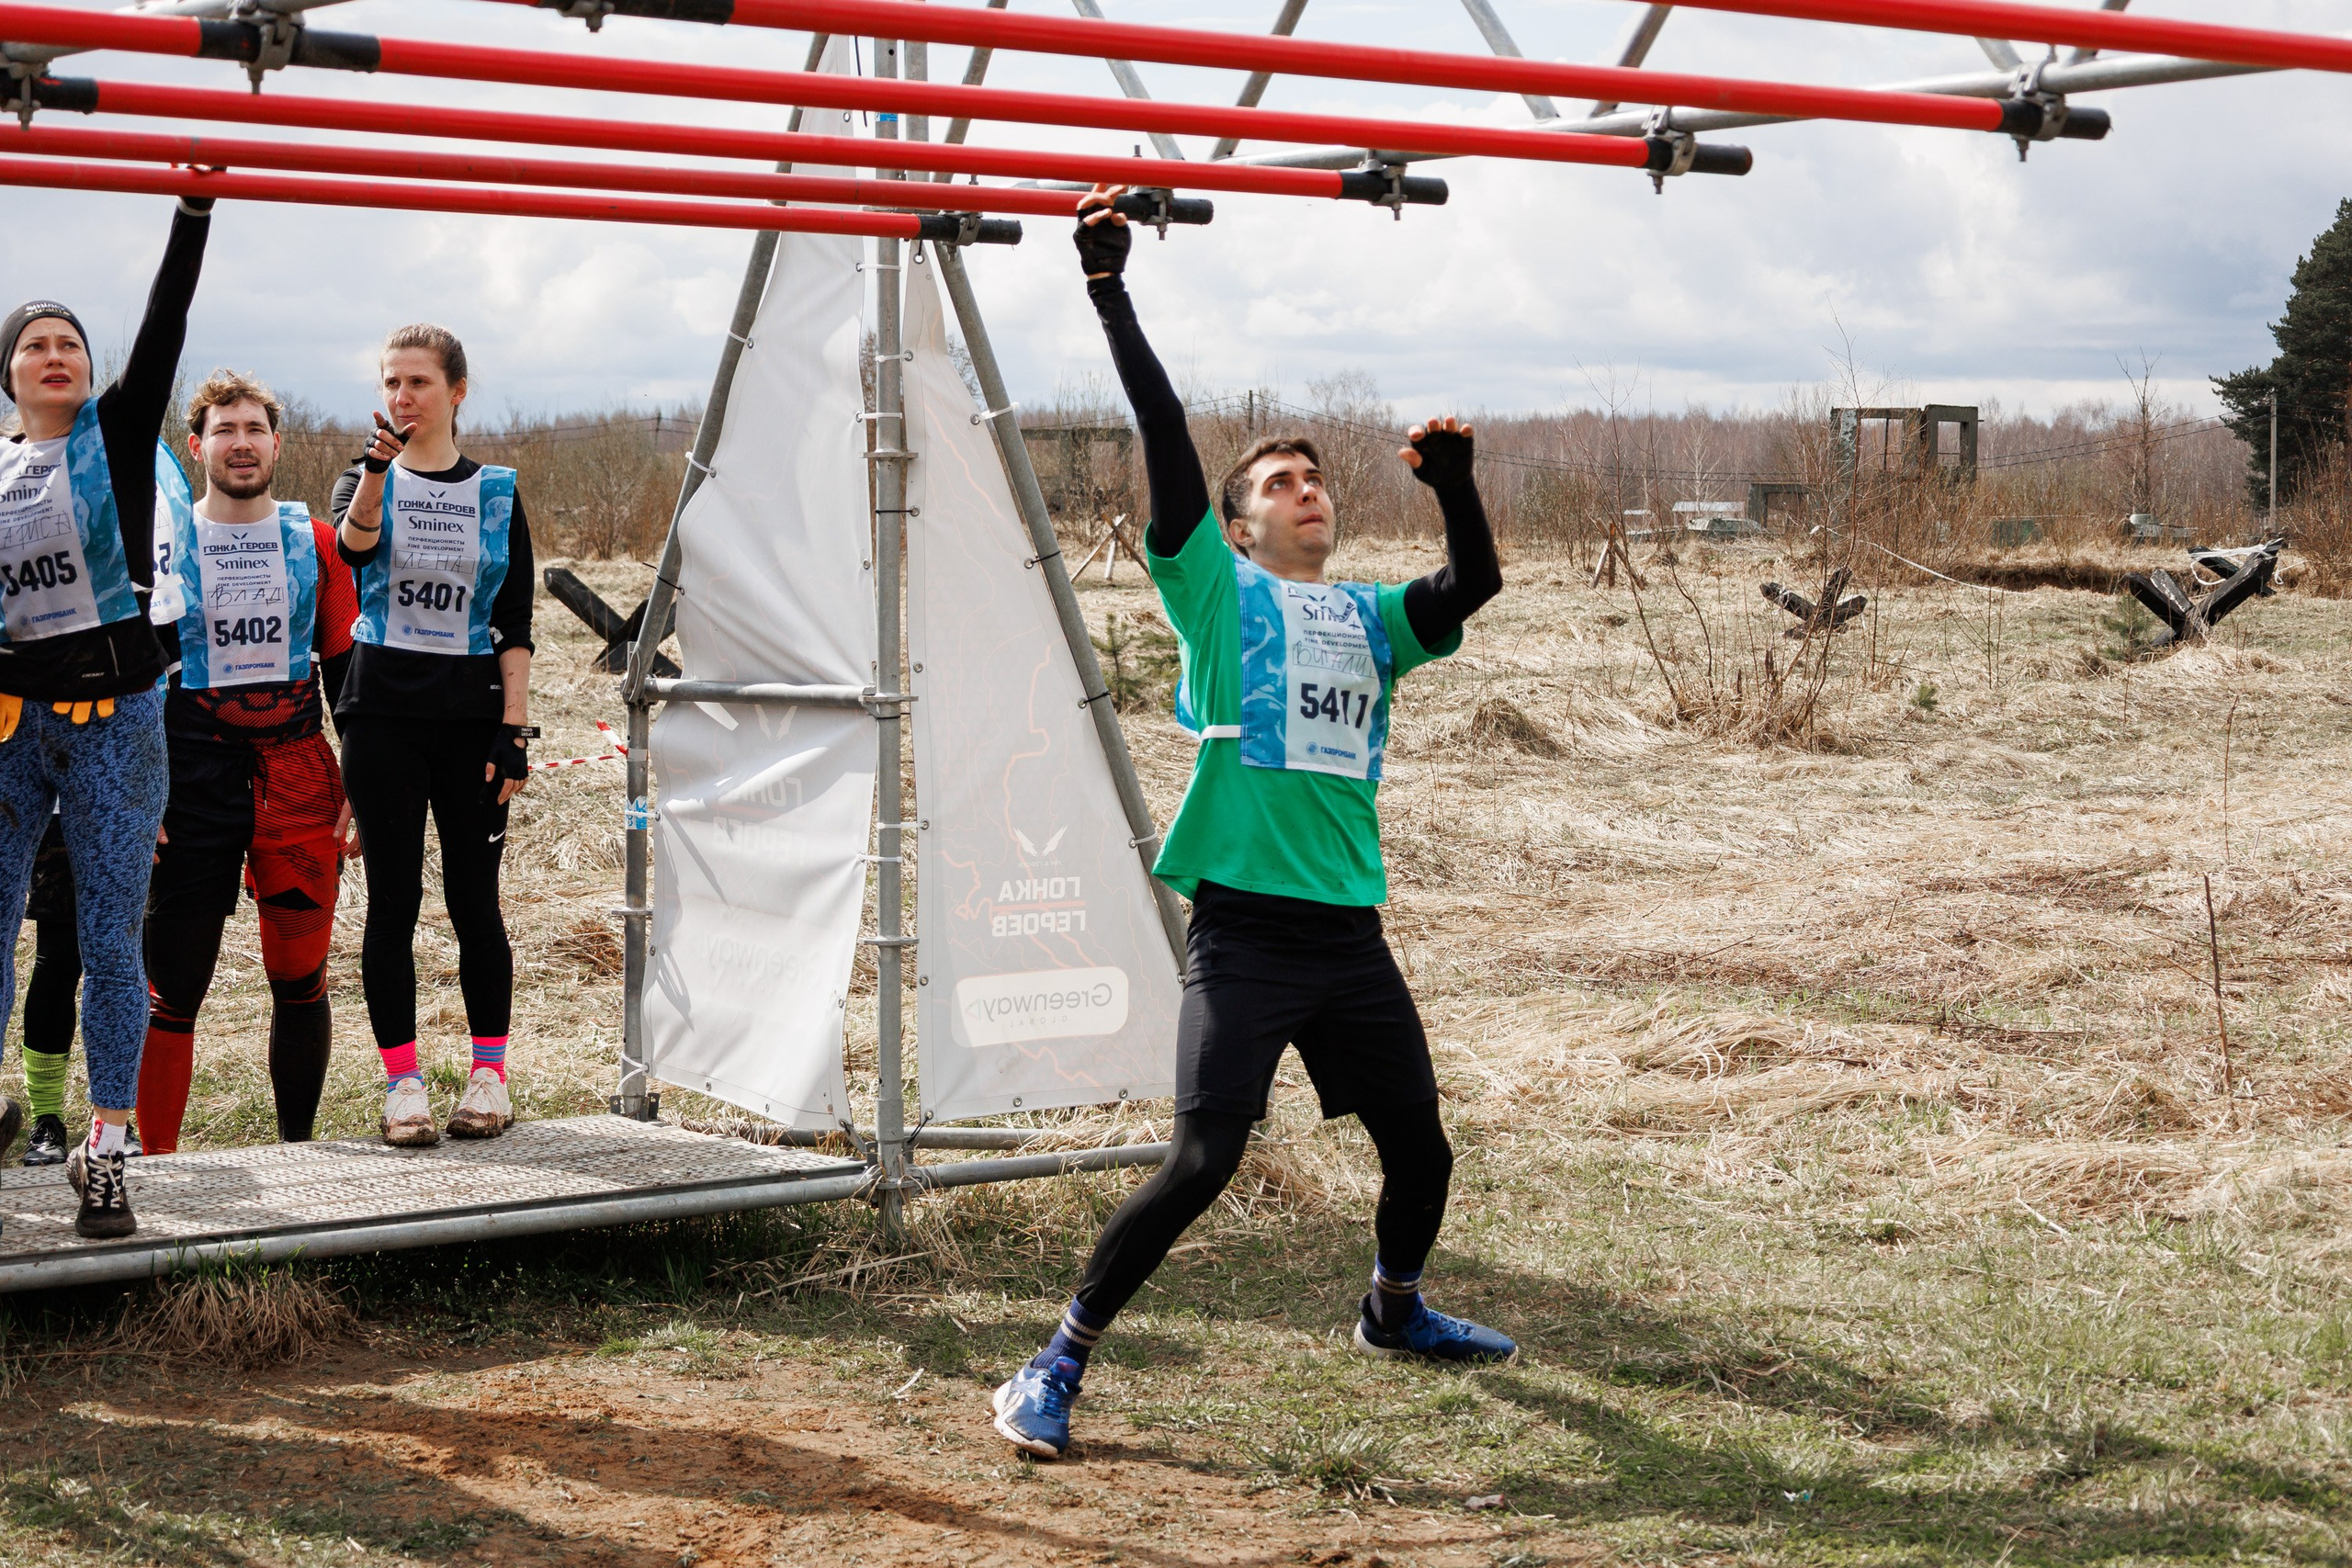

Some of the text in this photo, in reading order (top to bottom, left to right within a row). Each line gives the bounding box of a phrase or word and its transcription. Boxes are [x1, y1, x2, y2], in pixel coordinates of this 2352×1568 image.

[25, 463, 61, 475] ГЕРО
[13, 506, 53, 522] DEVELOPMENT
[398, 500, 476, 514] ГОНКА ГЕРОЕВ
[408, 515, 465, 534] Sminex
[203, 541, 278, 553] ГОНКА ГЕРОЕВ
[408, 536, 465, 545] ПЕРФЕКЦИОНИСТЫ
[215, 557, 270, 571] Sminex
[401, 552, 463, 573] ЛЕНА
[1, 550, 77, 597] 5405
[398, 580, 467, 613] 5401
[31, 607, 77, 624] ГАЗПРОМБАНК
[214, 615, 282, 648] 5402
[414, 627, 455, 638] ГАЗПРОМБАНК
[235, 661, 276, 671] ГАЗПРОМБАНК
[1300, 682, 1369, 728] 5411
[1320, 746, 1357, 761] ГАЗПРОМБАНК
